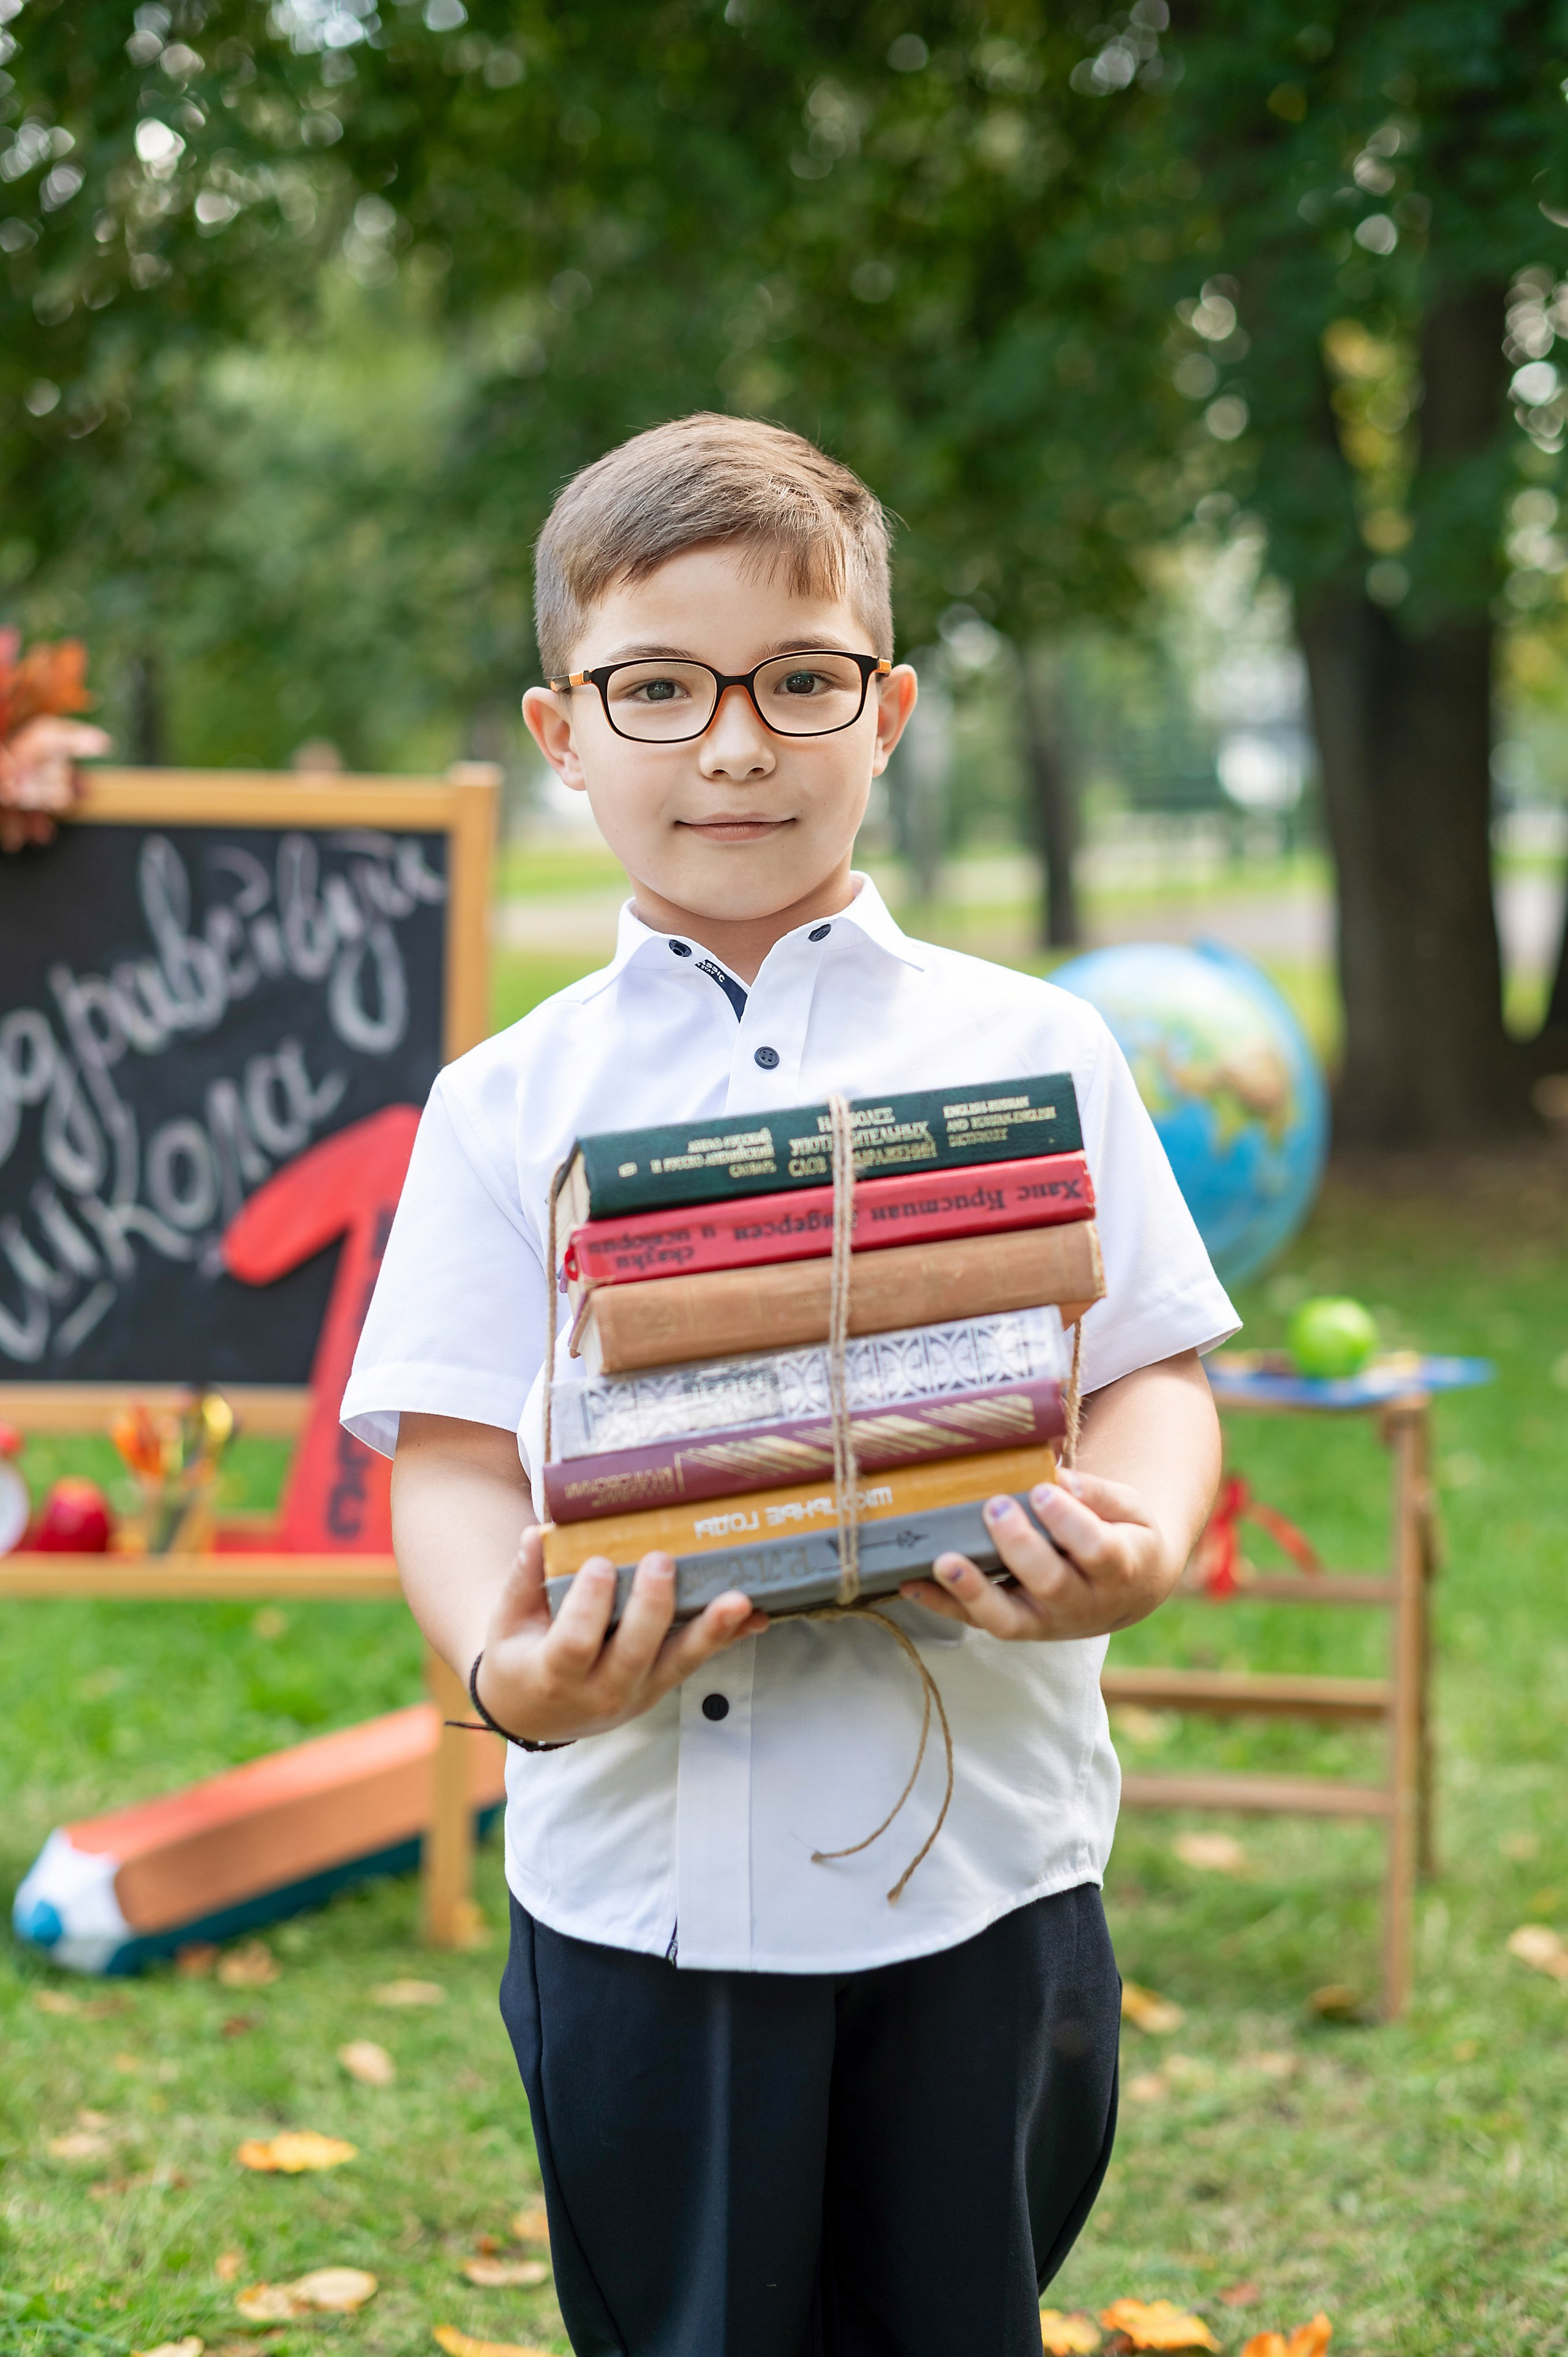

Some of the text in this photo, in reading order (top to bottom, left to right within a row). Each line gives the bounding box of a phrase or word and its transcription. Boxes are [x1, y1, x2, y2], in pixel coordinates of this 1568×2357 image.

[0, 830, 450, 1210] дравствуй
[946, 1118, 969, 1133] AND
[788, 1156, 827, 1177] СЛОВ
[733, 1178, 1082, 1242] Ханс Кристиан ндерсен
[693, 1510, 760, 1540] ГОДЫ
